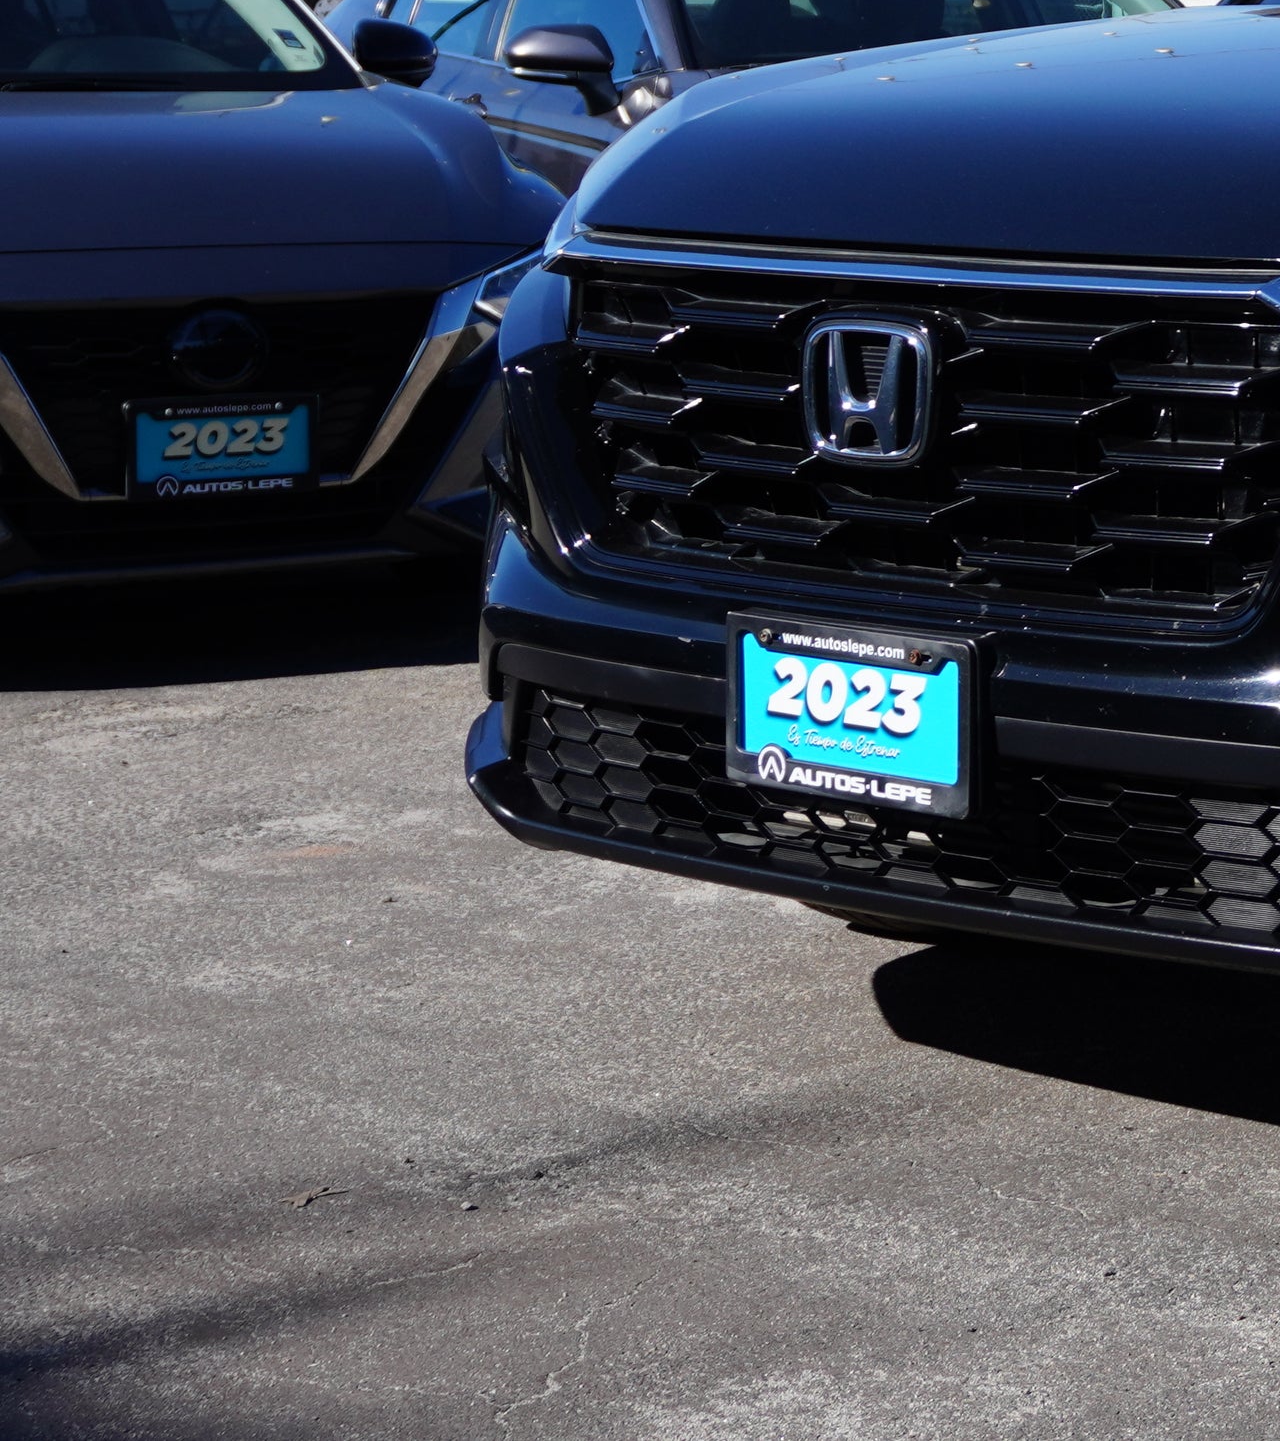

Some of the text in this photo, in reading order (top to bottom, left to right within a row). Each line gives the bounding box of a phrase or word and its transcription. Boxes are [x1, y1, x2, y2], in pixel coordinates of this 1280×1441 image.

[176, 403, 272, 415] www.autoslepe.com
[163, 417, 289, 458] 2023
[782, 632, 905, 660] www.autoslepe.com
[766, 656, 928, 736] 2023
[787, 724, 900, 759] Es Tiempo de Estrenar
